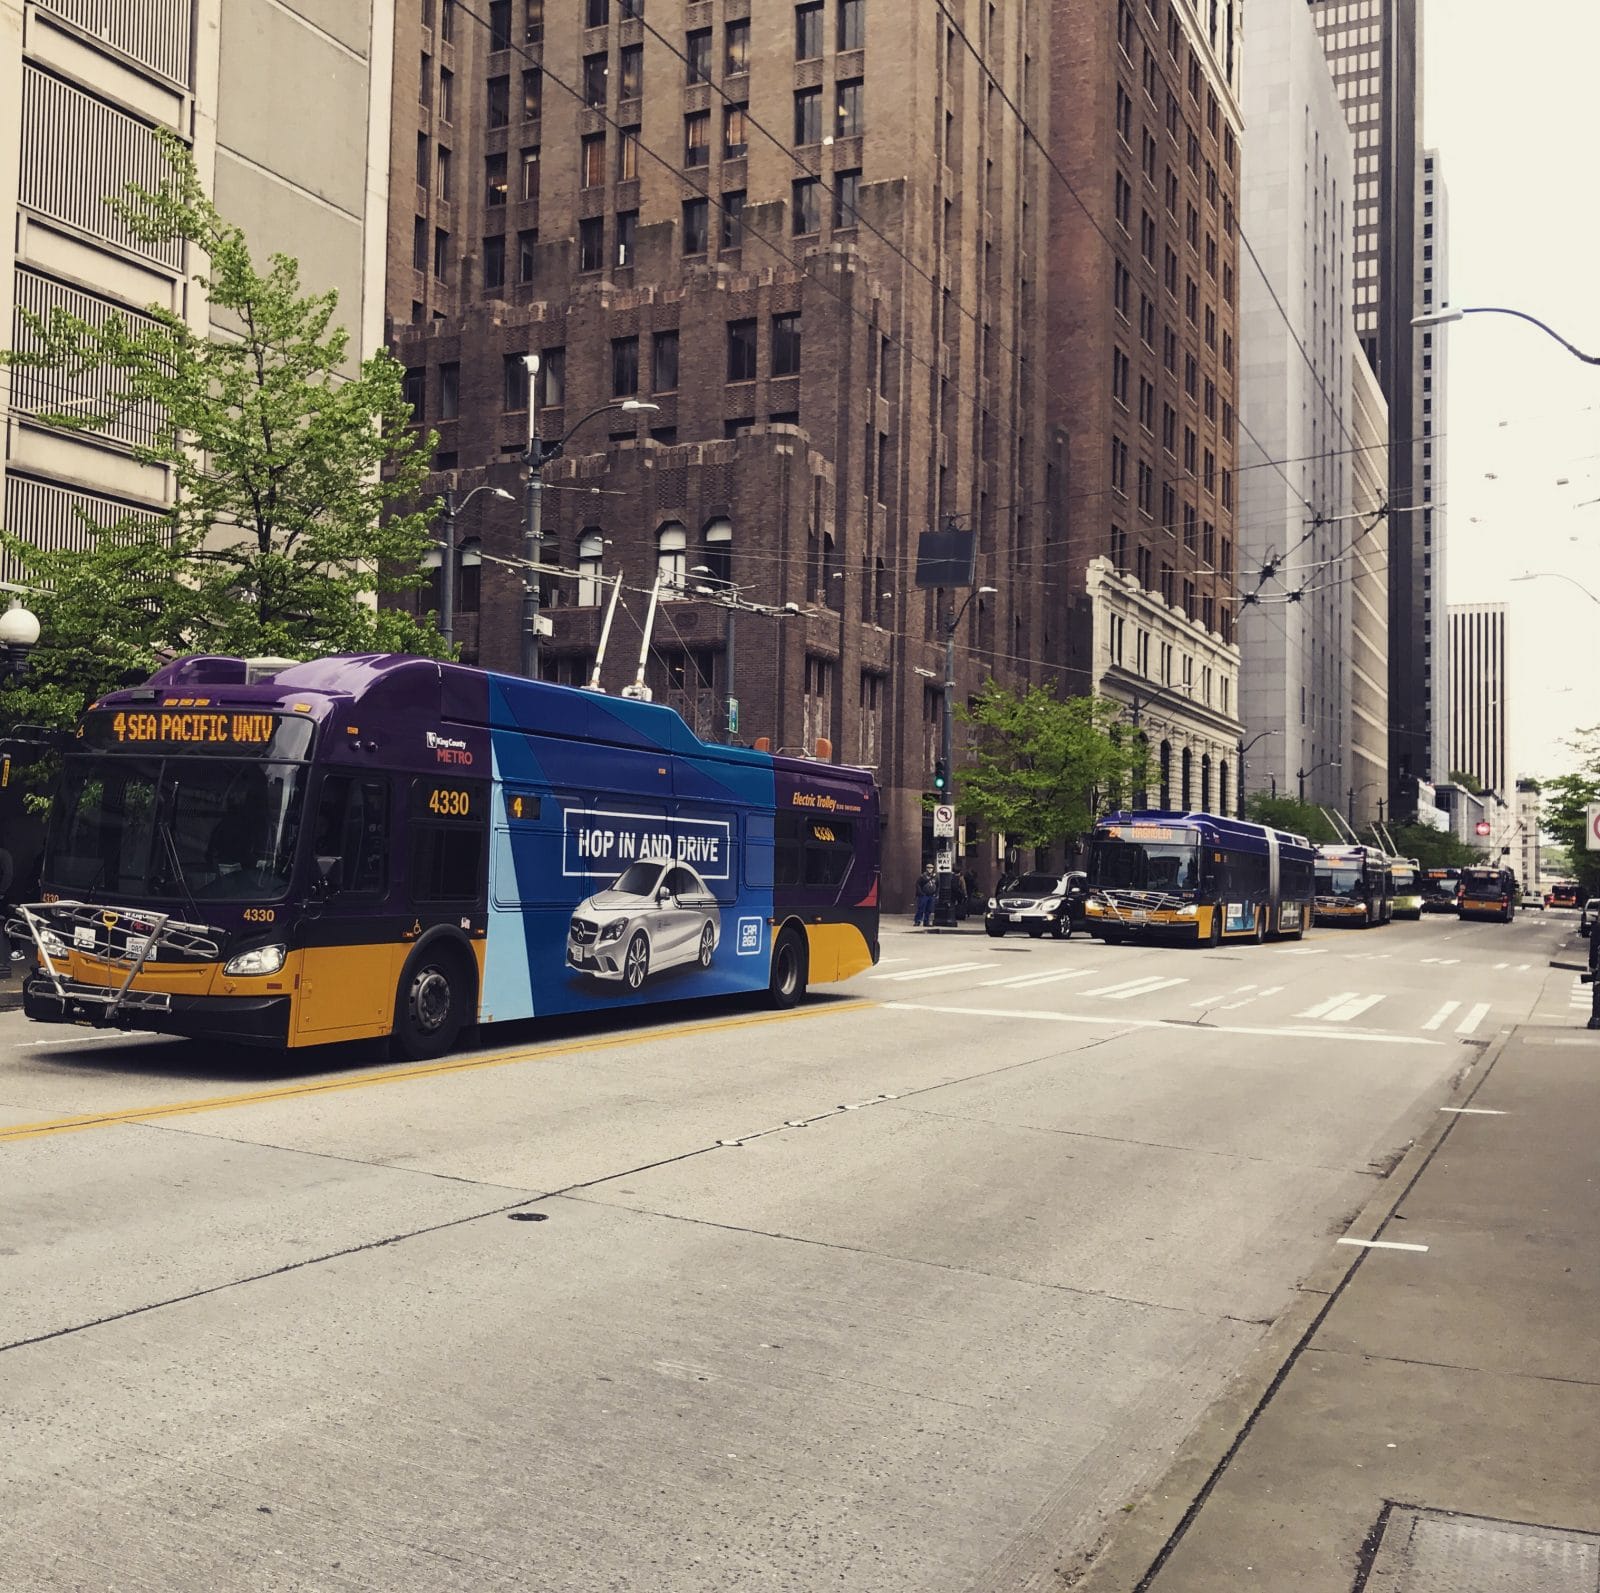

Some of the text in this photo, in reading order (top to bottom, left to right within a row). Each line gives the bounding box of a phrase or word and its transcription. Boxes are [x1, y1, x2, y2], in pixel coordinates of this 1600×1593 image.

[113, 712, 273, 742] 4 SEA PACIFIC UNIV
[436, 737, 466, 750] King County
[436, 749, 473, 765] METRO
[429, 789, 469, 816] 4330
[513, 797, 523, 818] 4
[792, 792, 815, 807] Electric
[816, 795, 837, 812] Trolley
[578, 828, 719, 862] HOP IN AND DRIVE
[243, 908, 275, 922] 4330
[742, 924, 758, 936] CAR
